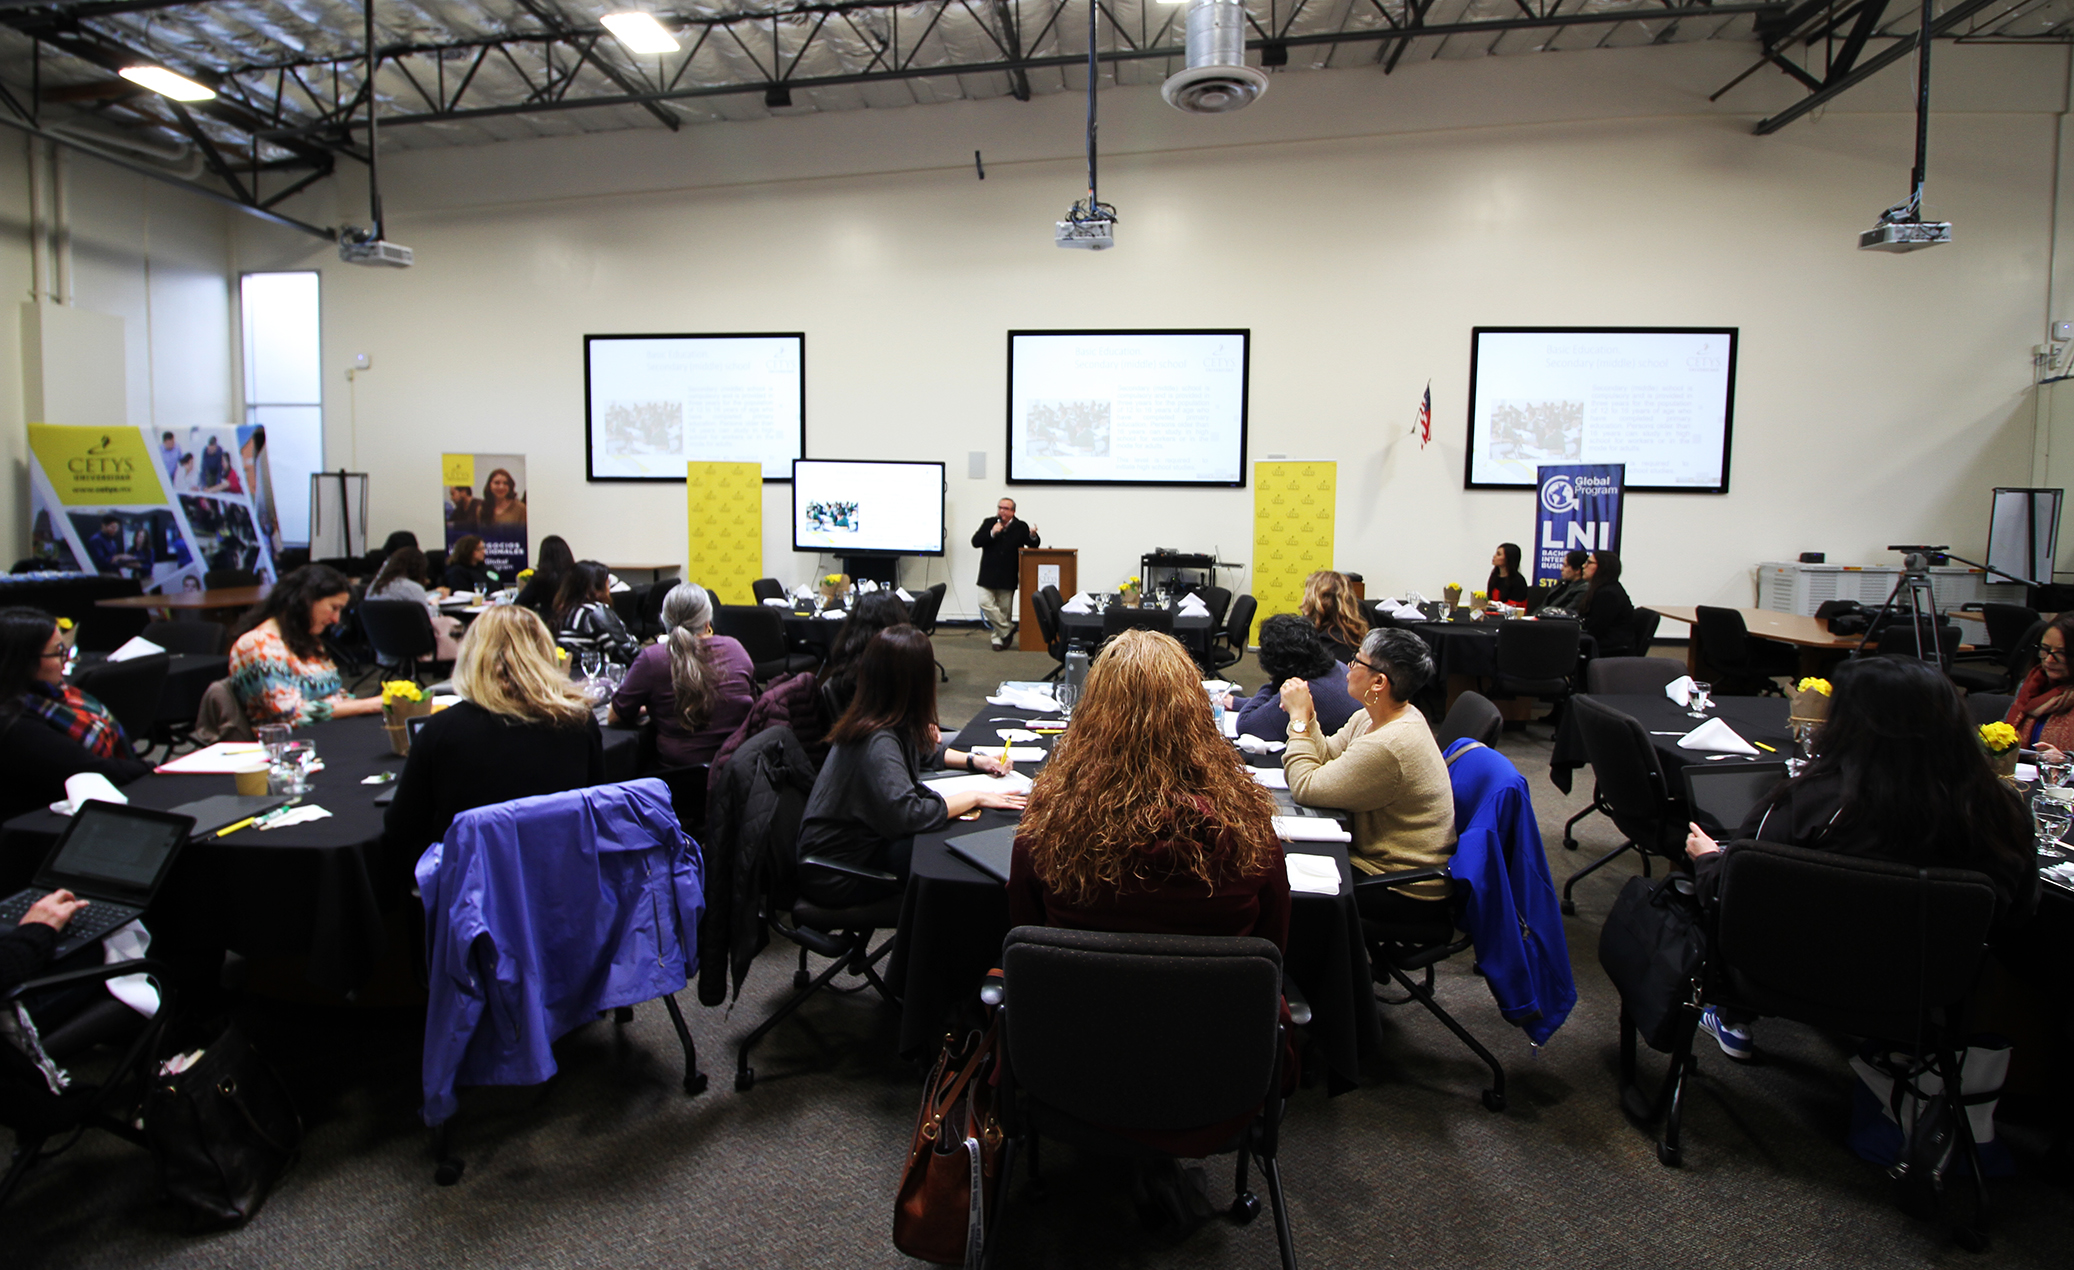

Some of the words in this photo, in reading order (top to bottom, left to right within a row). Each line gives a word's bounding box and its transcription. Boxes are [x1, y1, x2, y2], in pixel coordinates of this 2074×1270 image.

[1075, 346, 1096, 356] Basic
[1074, 360, 1119, 370] Secondary
[1121, 360, 1156, 370] (middle)
[1159, 360, 1187, 369] school
[1203, 358, 1236, 367] CETYS
[1546, 358, 1594, 370] Secondary
[1638, 358, 1668, 368] school
[68, 457, 134, 473] CETYS
[1574, 476, 1610, 486] Global
[1574, 485, 1618, 496] Program
[1542, 520, 1610, 550] LNI
